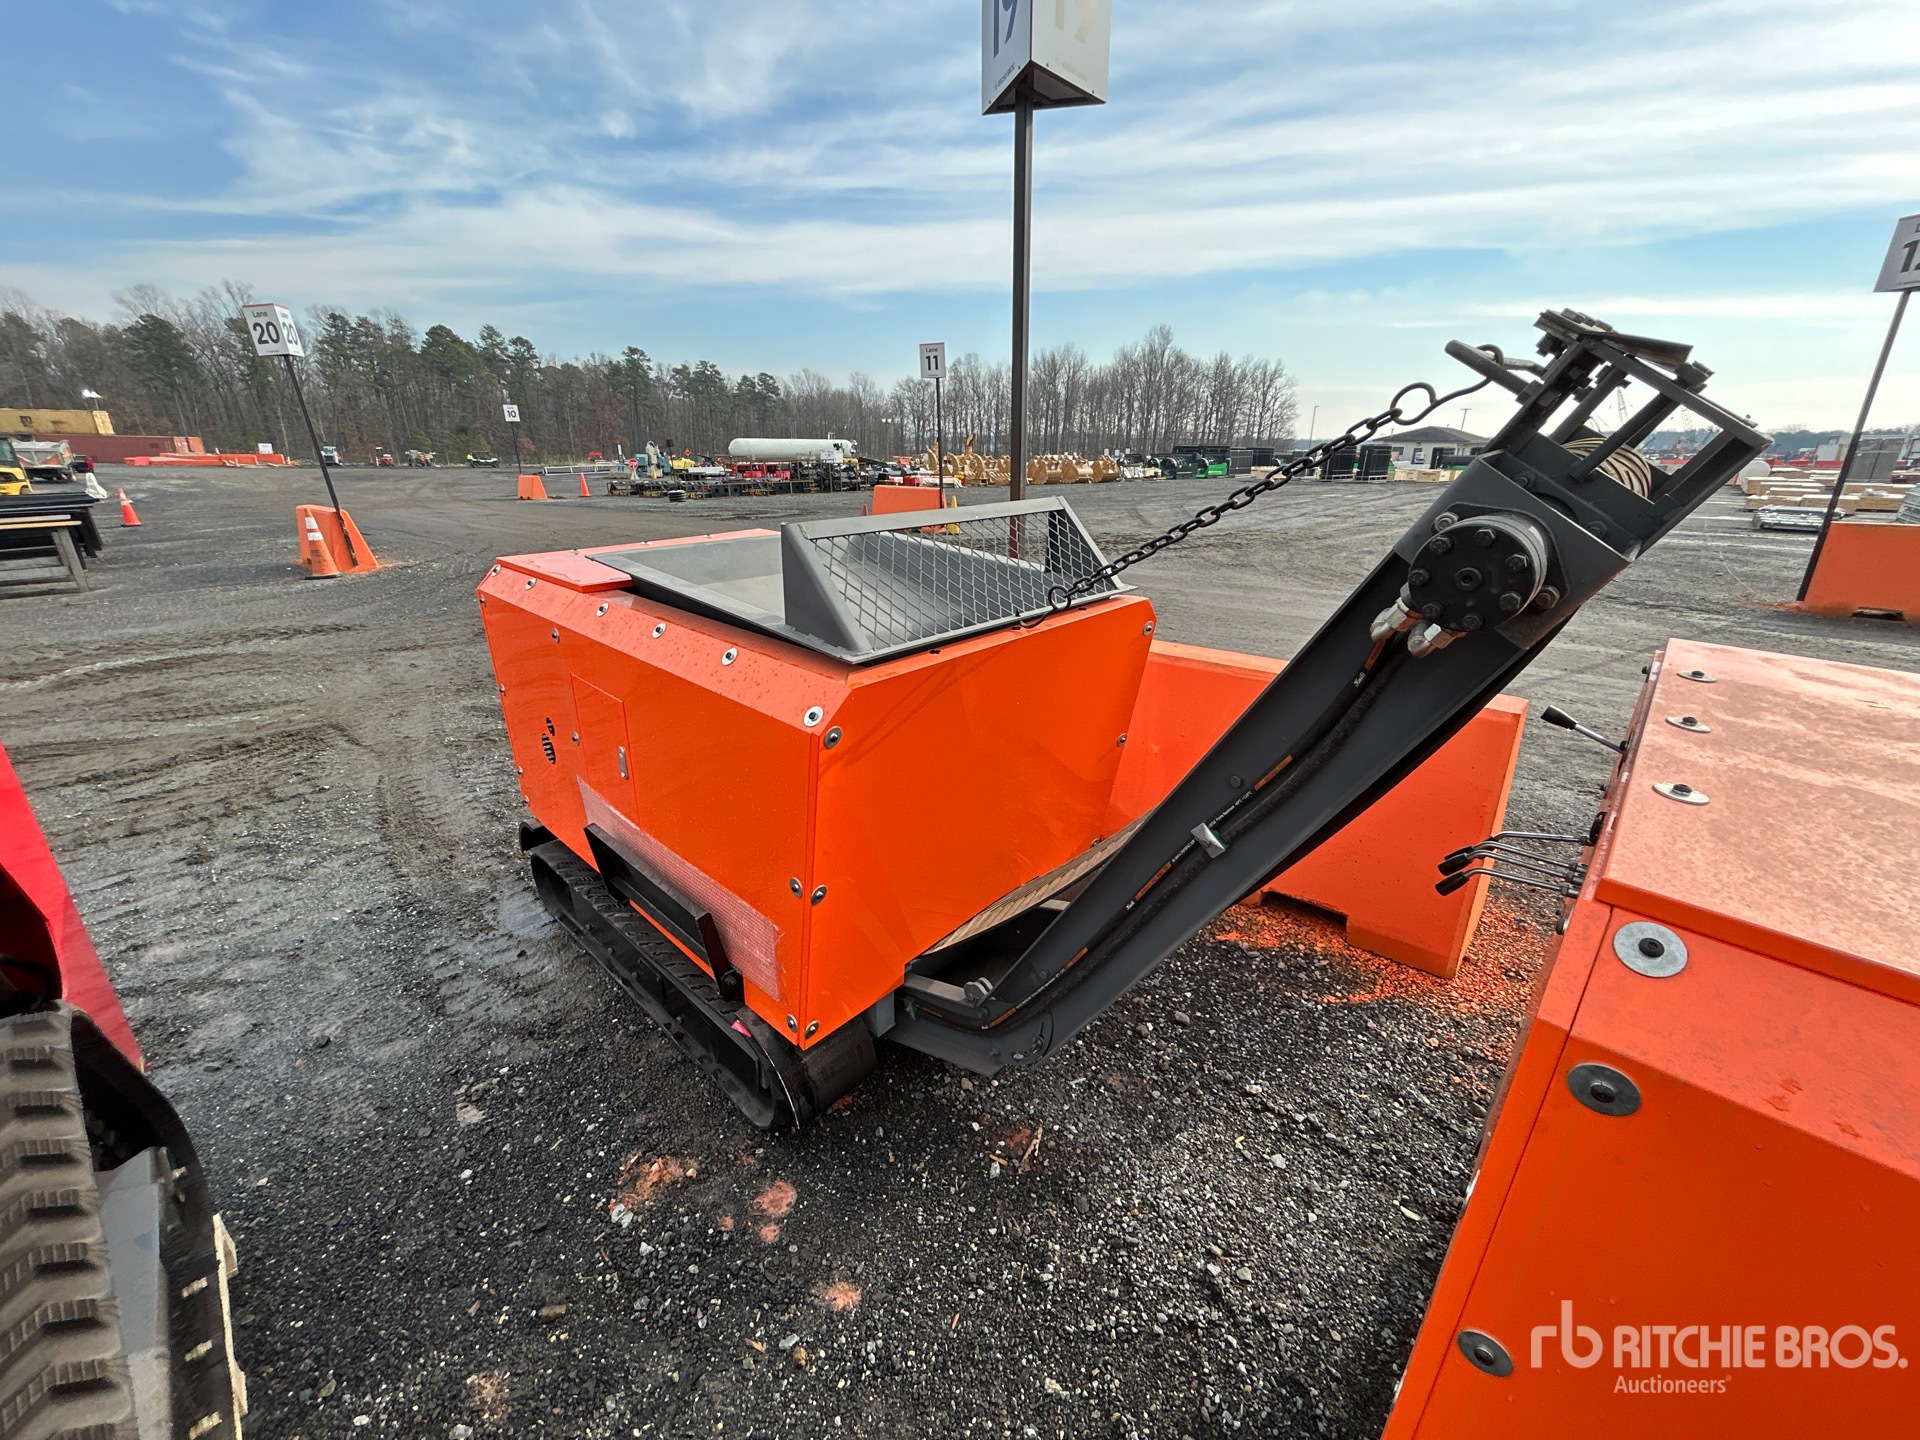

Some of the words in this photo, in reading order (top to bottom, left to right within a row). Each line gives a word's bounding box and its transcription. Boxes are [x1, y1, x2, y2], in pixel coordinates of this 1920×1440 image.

[1900, 239, 1920, 274] 1
[253, 321, 280, 345] 20
[282, 322, 298, 345] 20
[925, 355, 938, 371] 11
[507, 410, 517, 418] 10
